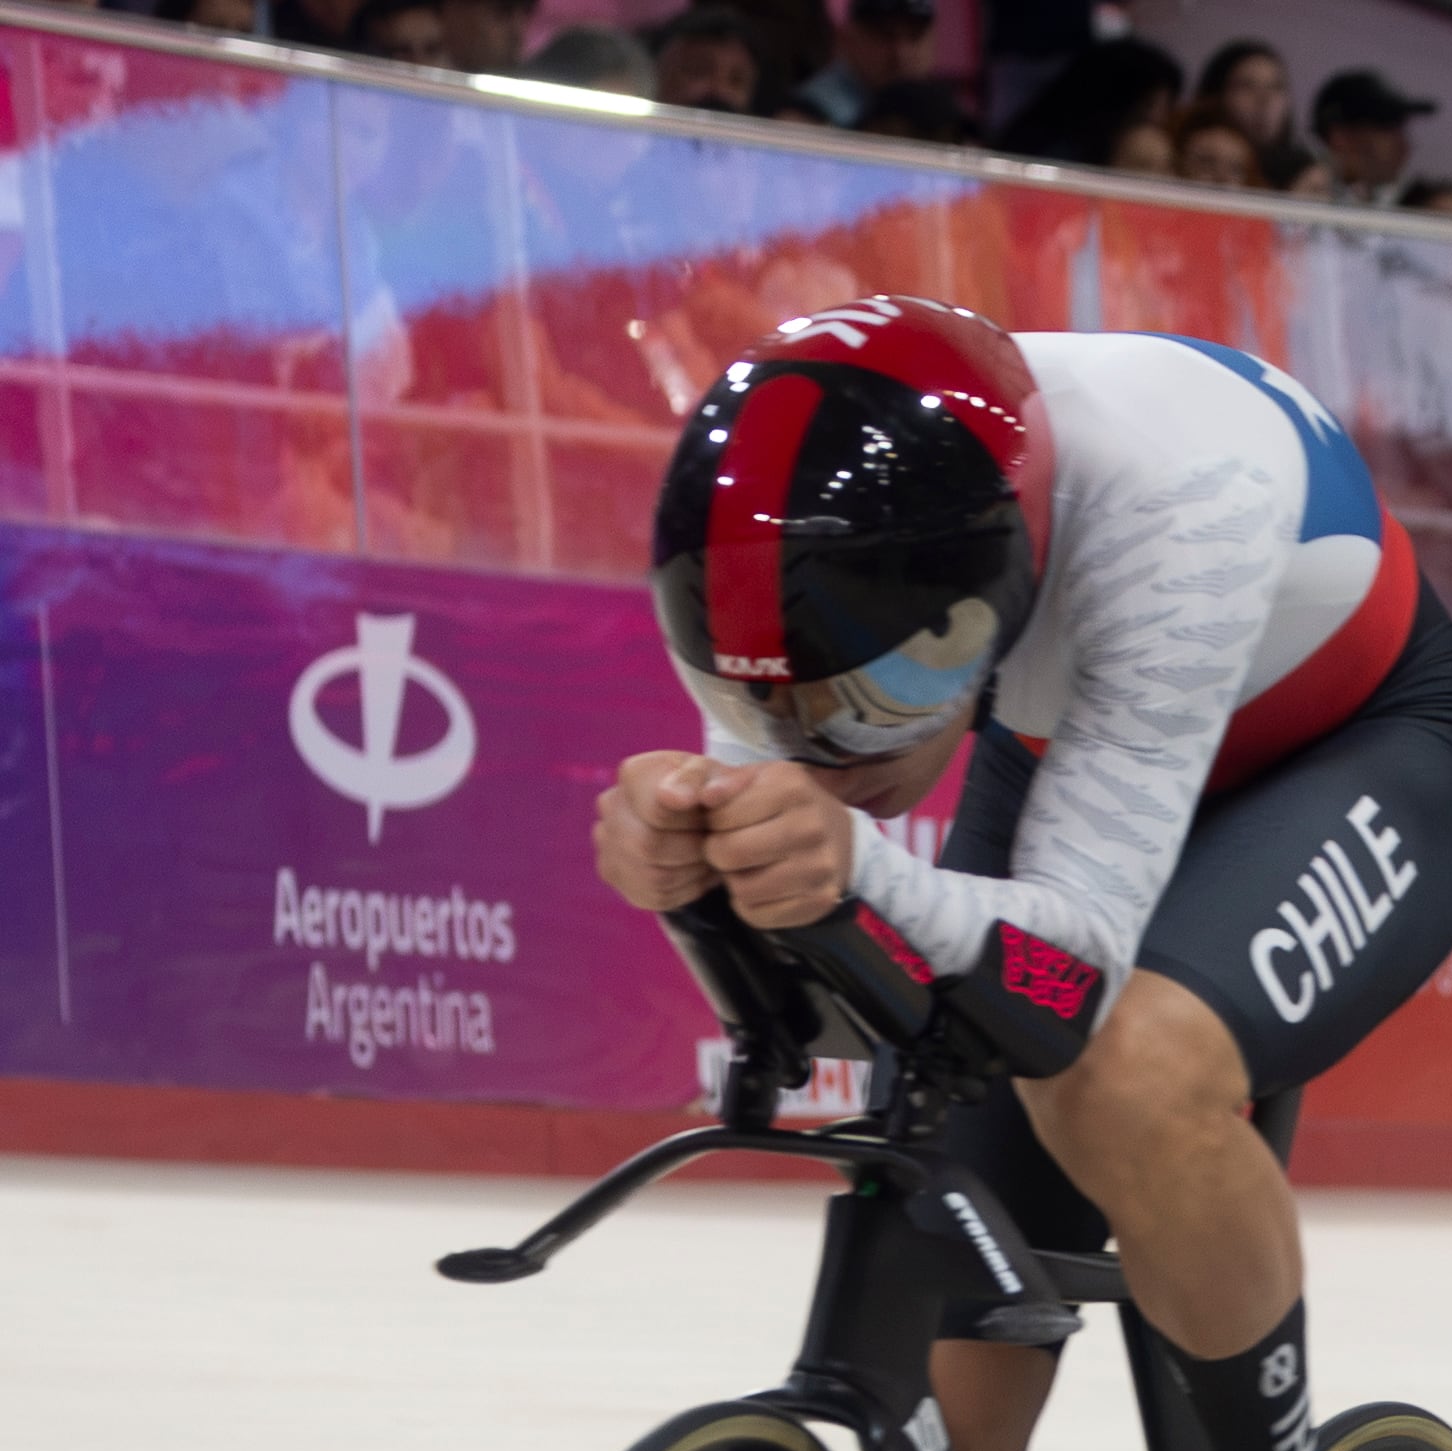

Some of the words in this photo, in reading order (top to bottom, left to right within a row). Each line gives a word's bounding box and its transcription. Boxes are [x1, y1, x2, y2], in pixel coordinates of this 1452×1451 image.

[273, 866, 516, 971] Aeropuertos
[1248, 794, 1419, 1025] CHILE
[304, 961, 495, 1068] Argentina
